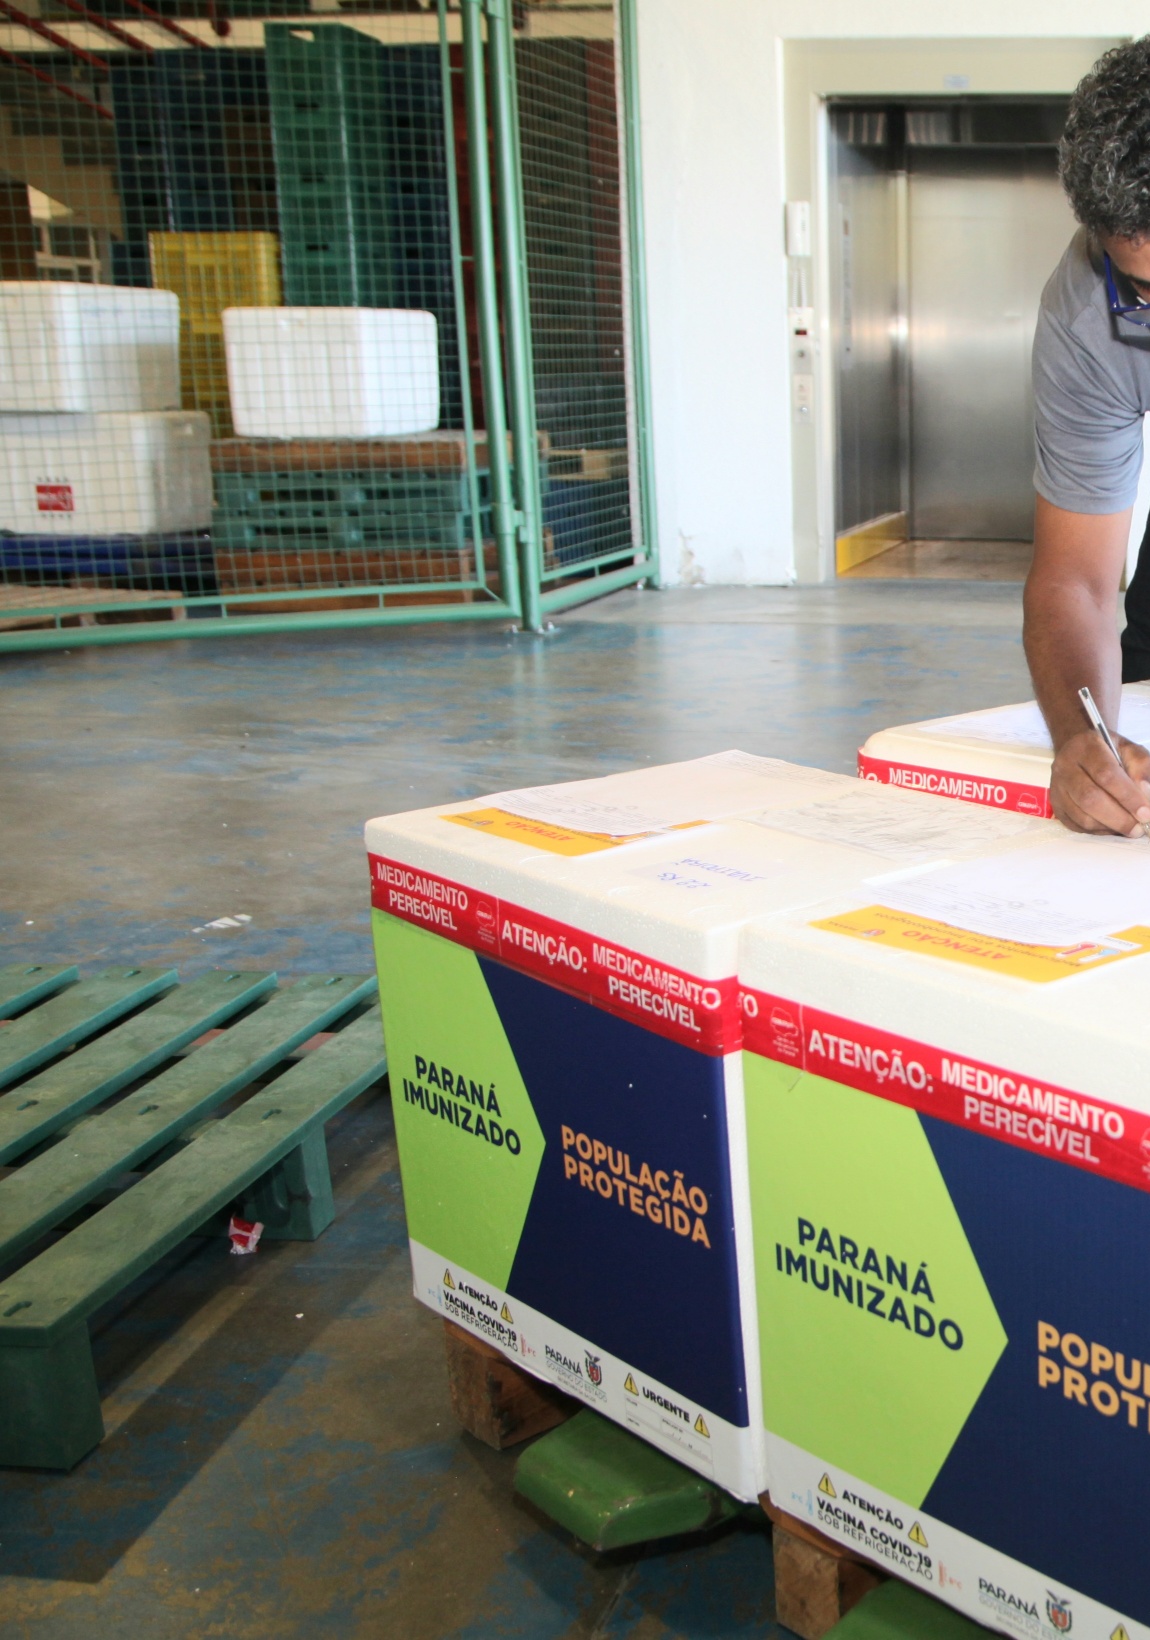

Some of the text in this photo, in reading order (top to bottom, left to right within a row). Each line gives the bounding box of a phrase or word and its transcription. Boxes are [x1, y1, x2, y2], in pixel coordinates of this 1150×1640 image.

[888, 767, 1007, 804] MEDICAMENTO
[504, 821, 576, 842] ATENÇÃO
[376, 862, 469, 911] MEDICAMENTO
[389, 890, 458, 931] PERECÍVEL
[502, 920, 588, 973] ATENÇÃO:
[592, 943, 721, 1010] MEDICAMENTO
[902, 930, 1011, 960] ATENÇÃO
[608, 975, 702, 1031] PERECÍVEL
[415, 1054, 502, 1118] PARANÁ
[809, 1029, 1125, 1140] ATENÇÃO: MEDICAMENTO
[403, 1078, 521, 1156] IMUNIZADO
[964, 1095, 1100, 1164] PERECÍVEL
[561, 1124, 709, 1216] POPULAÇÃO
[563, 1153, 711, 1249] PROTEGIDA
[798, 1217, 935, 1304] PARANÁ
[443, 1290, 517, 1342] VACINA COVID-19
[458, 1281, 498, 1311] ATENÇÃO
[776, 1242, 964, 1351] IMUNIZADO
[444, 1302, 519, 1352] SOB REFRIGERAÇÃO
[545, 1344, 584, 1378] PARANÁ
[585, 1383, 608, 1403] ESTADO
[642, 1386, 690, 1423] URGENTE
[816, 1496, 932, 1568] VACINA COVID-19
[842, 1489, 904, 1530] ATENÇÃO
[817, 1510, 933, 1581] SOB REFRIGERAÇÃO
[978, 1576, 1040, 1620] PARANÁ
[978, 1595, 1040, 1634] GOVERNO DO
